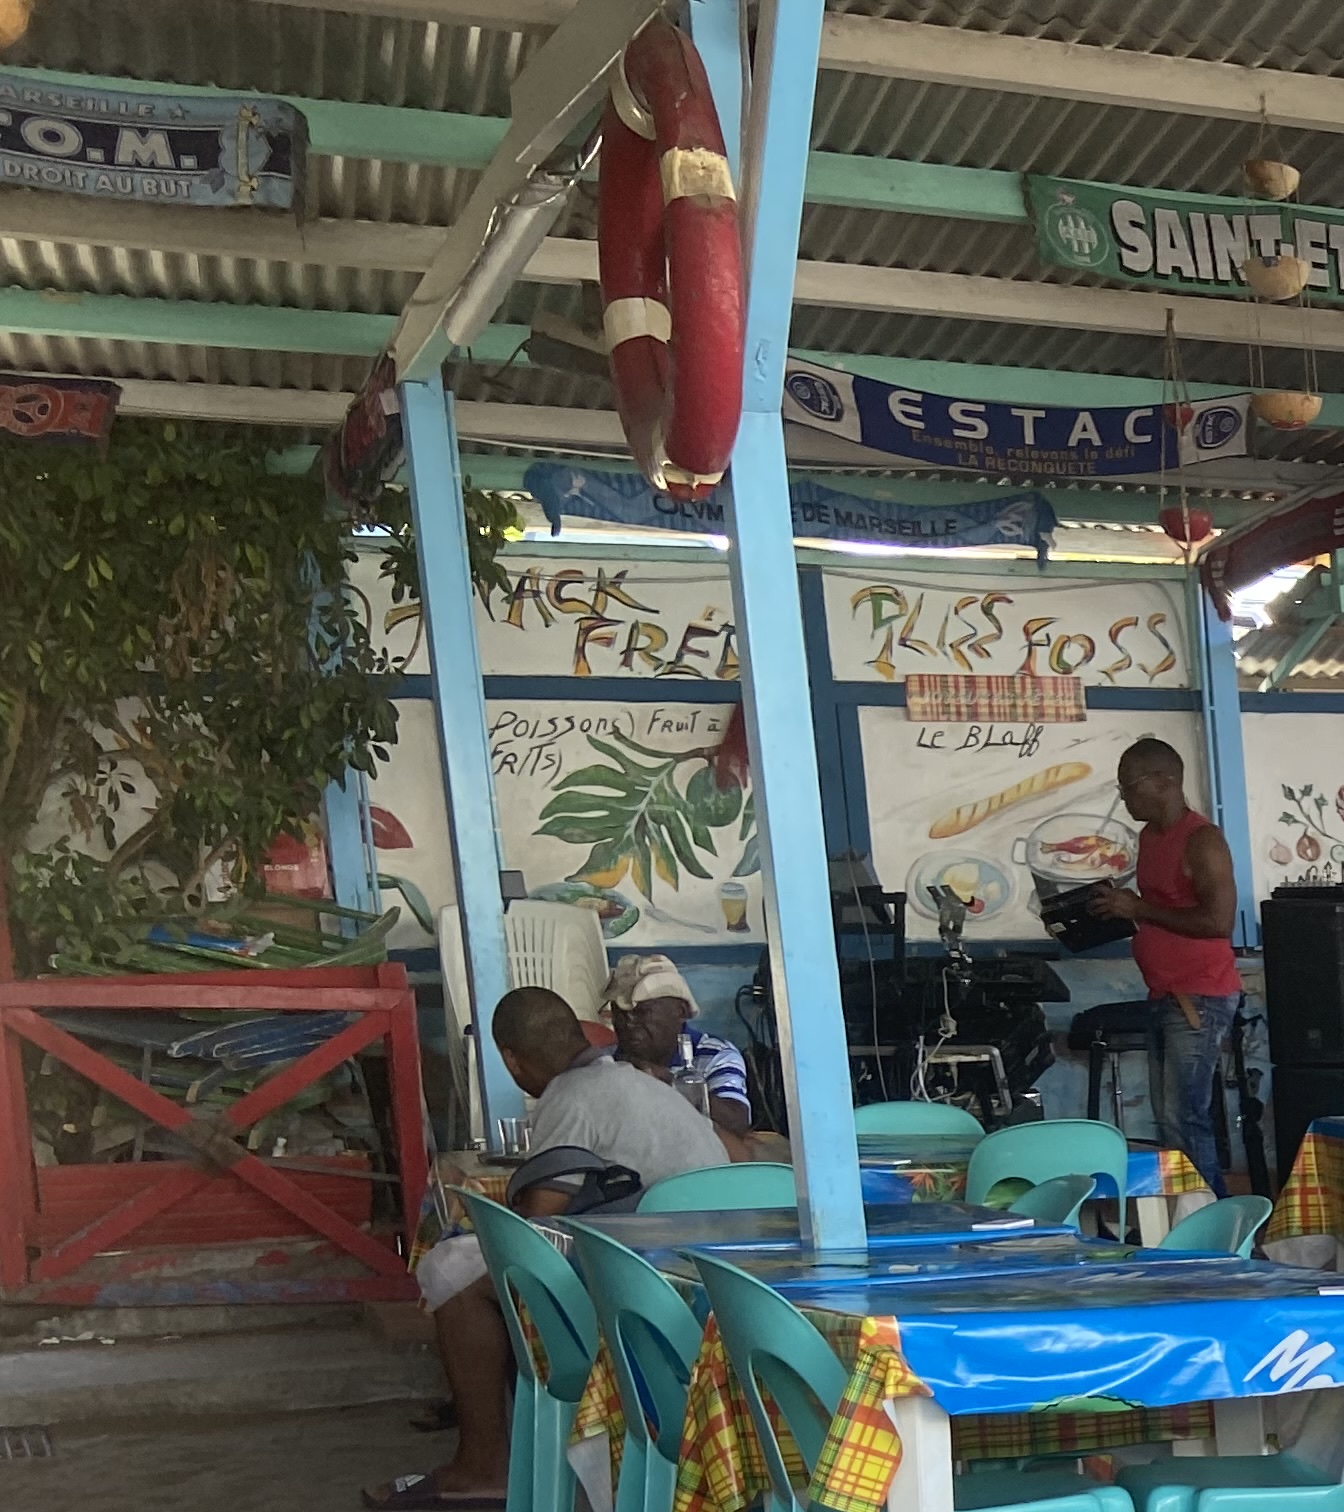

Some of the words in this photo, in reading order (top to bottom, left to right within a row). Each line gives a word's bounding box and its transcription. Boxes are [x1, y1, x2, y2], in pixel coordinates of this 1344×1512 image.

[0, 110, 198, 169] O.M.
[4, 159, 87, 189] DROIT
[96, 174, 133, 194] AU
[142, 178, 192, 198] BUT
[888, 389, 1154, 447] ESTAC
[958, 453, 979, 468] LA
[1085, 448, 1098, 459] le
[803, 501, 830, 525] DE
[833, 507, 958, 537] MARSEILLE
